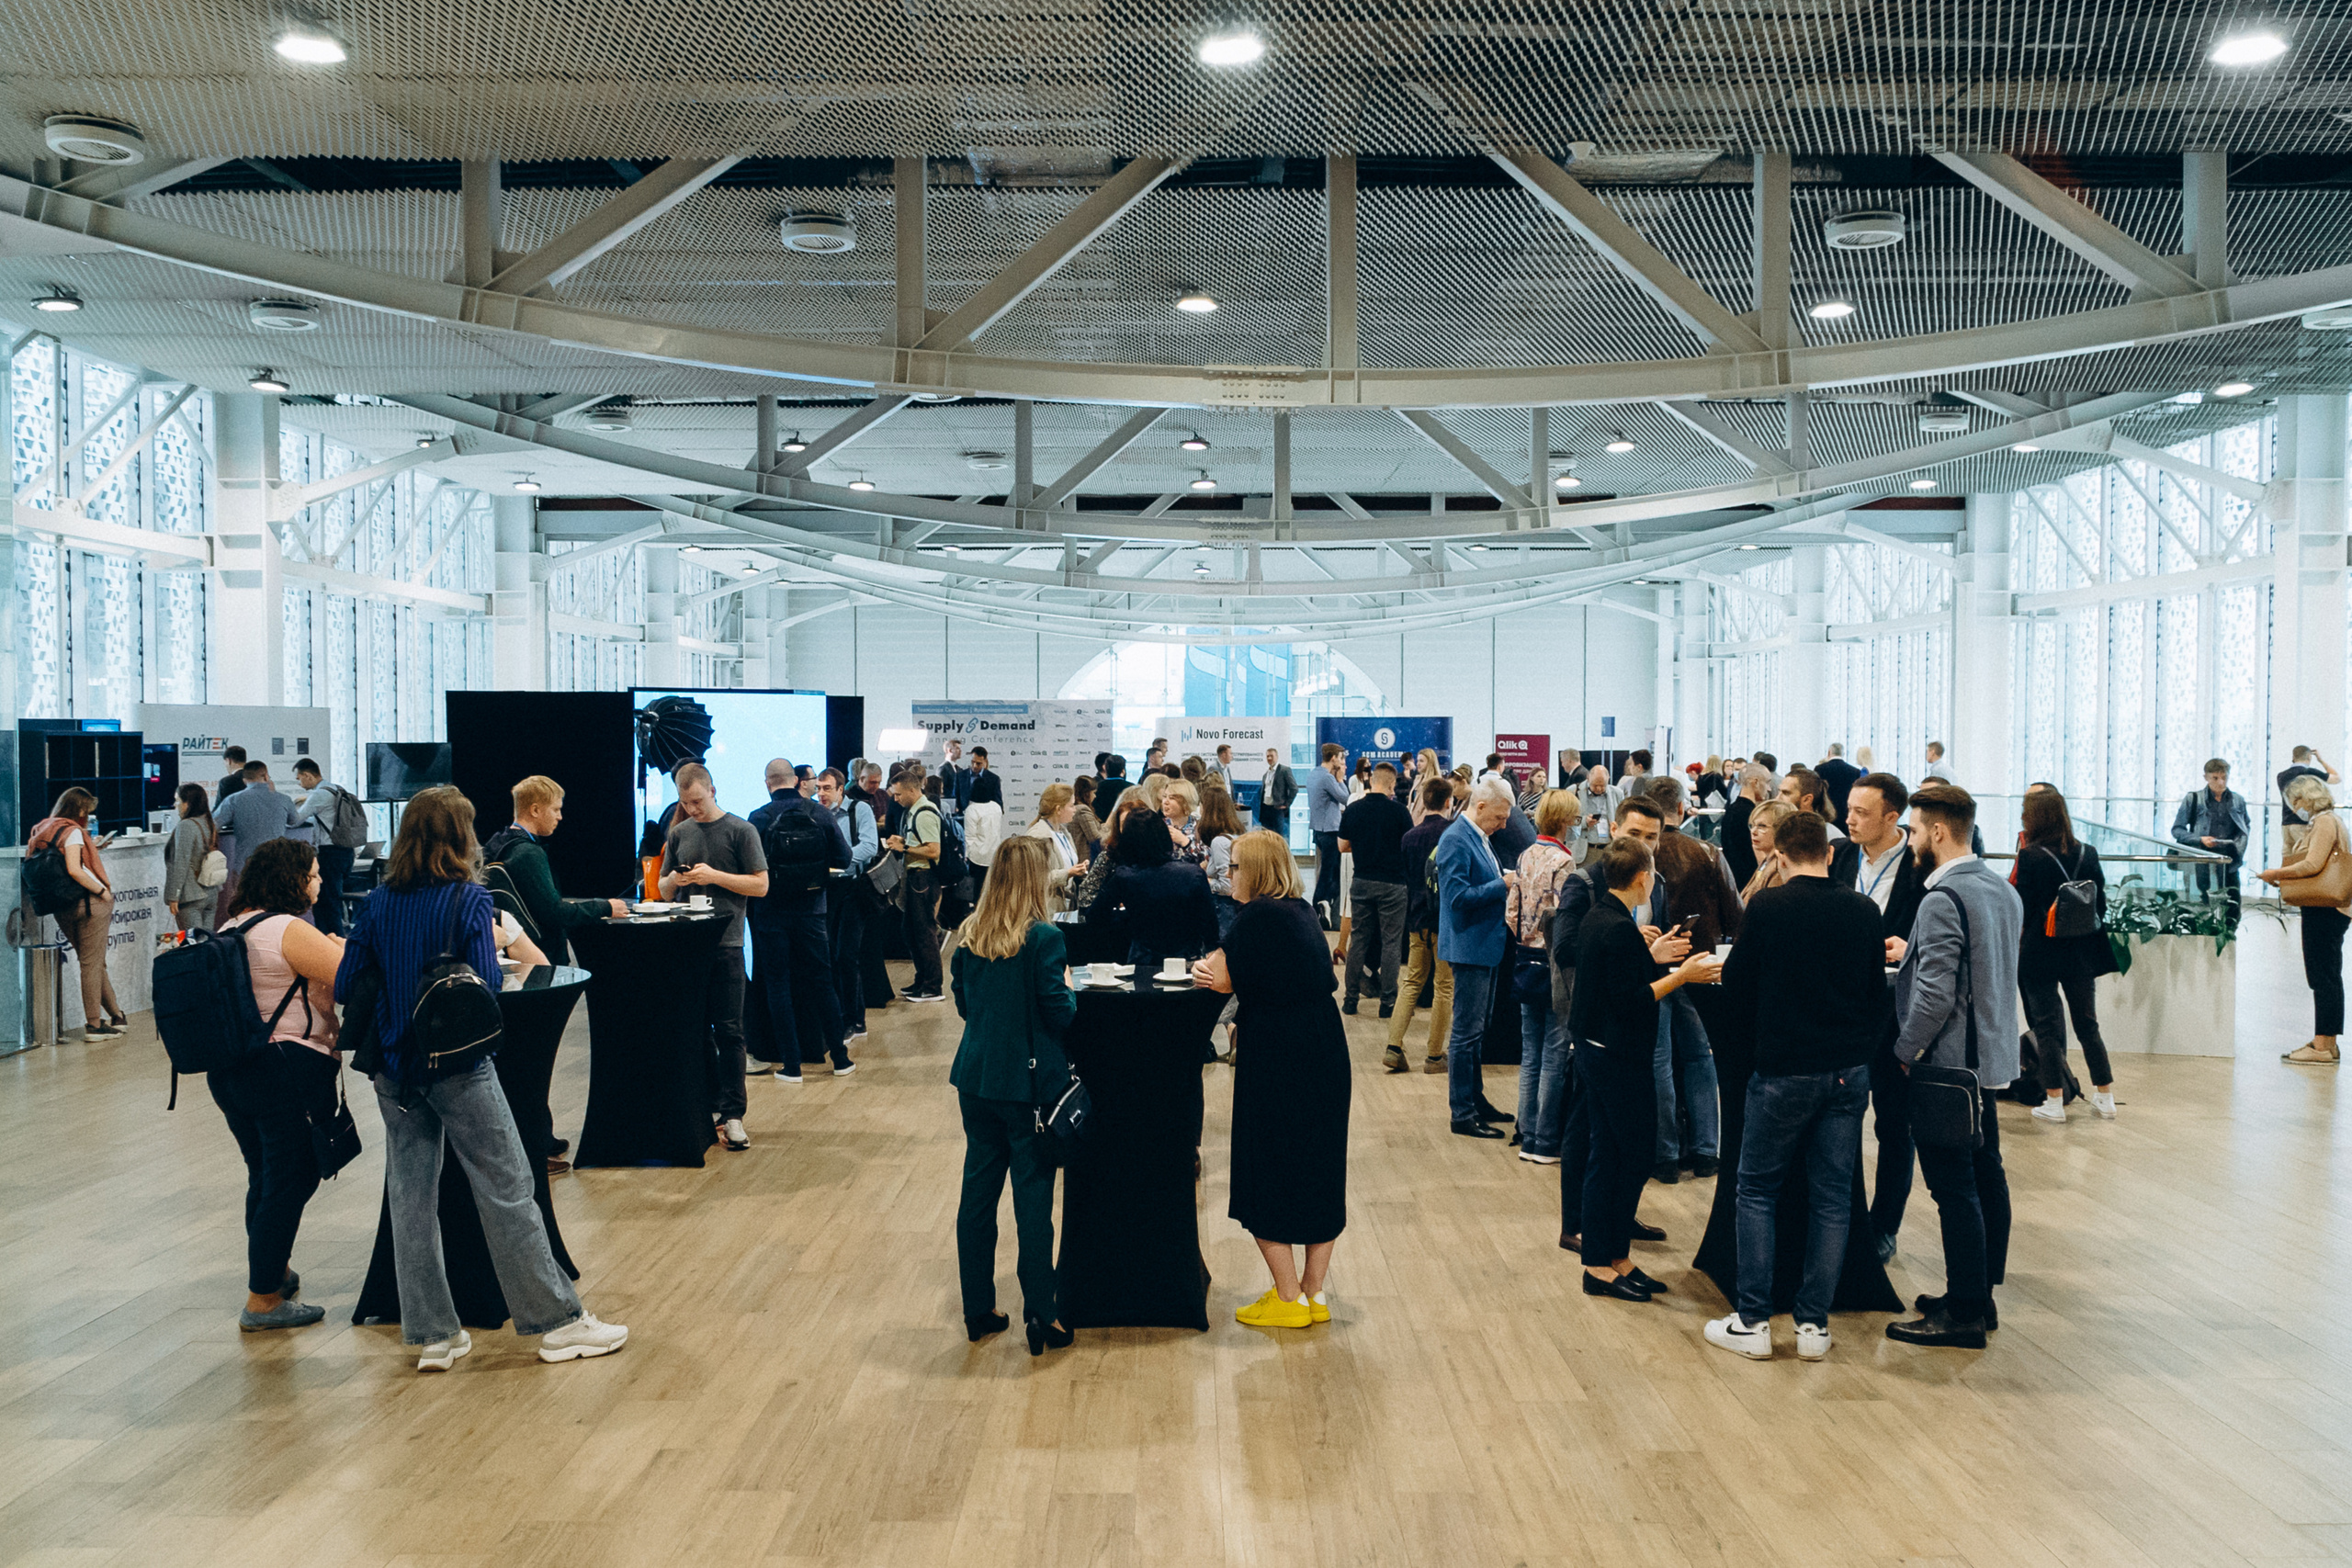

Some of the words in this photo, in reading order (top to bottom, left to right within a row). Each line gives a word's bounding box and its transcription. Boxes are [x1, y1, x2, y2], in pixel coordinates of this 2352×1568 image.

[918, 720, 964, 733] Supply
[980, 719, 1035, 730] Demand
[1196, 728, 1220, 739] Novo
[1223, 728, 1264, 739] Forecast
[183, 734, 229, 750] РАЙТЕК
[971, 735, 1035, 743] Conference
[1497, 740, 1518, 750] Qlik
[112, 886, 159, 903] когольная
[110, 908, 153, 926] ибирская
[107, 931, 135, 950] руппа
